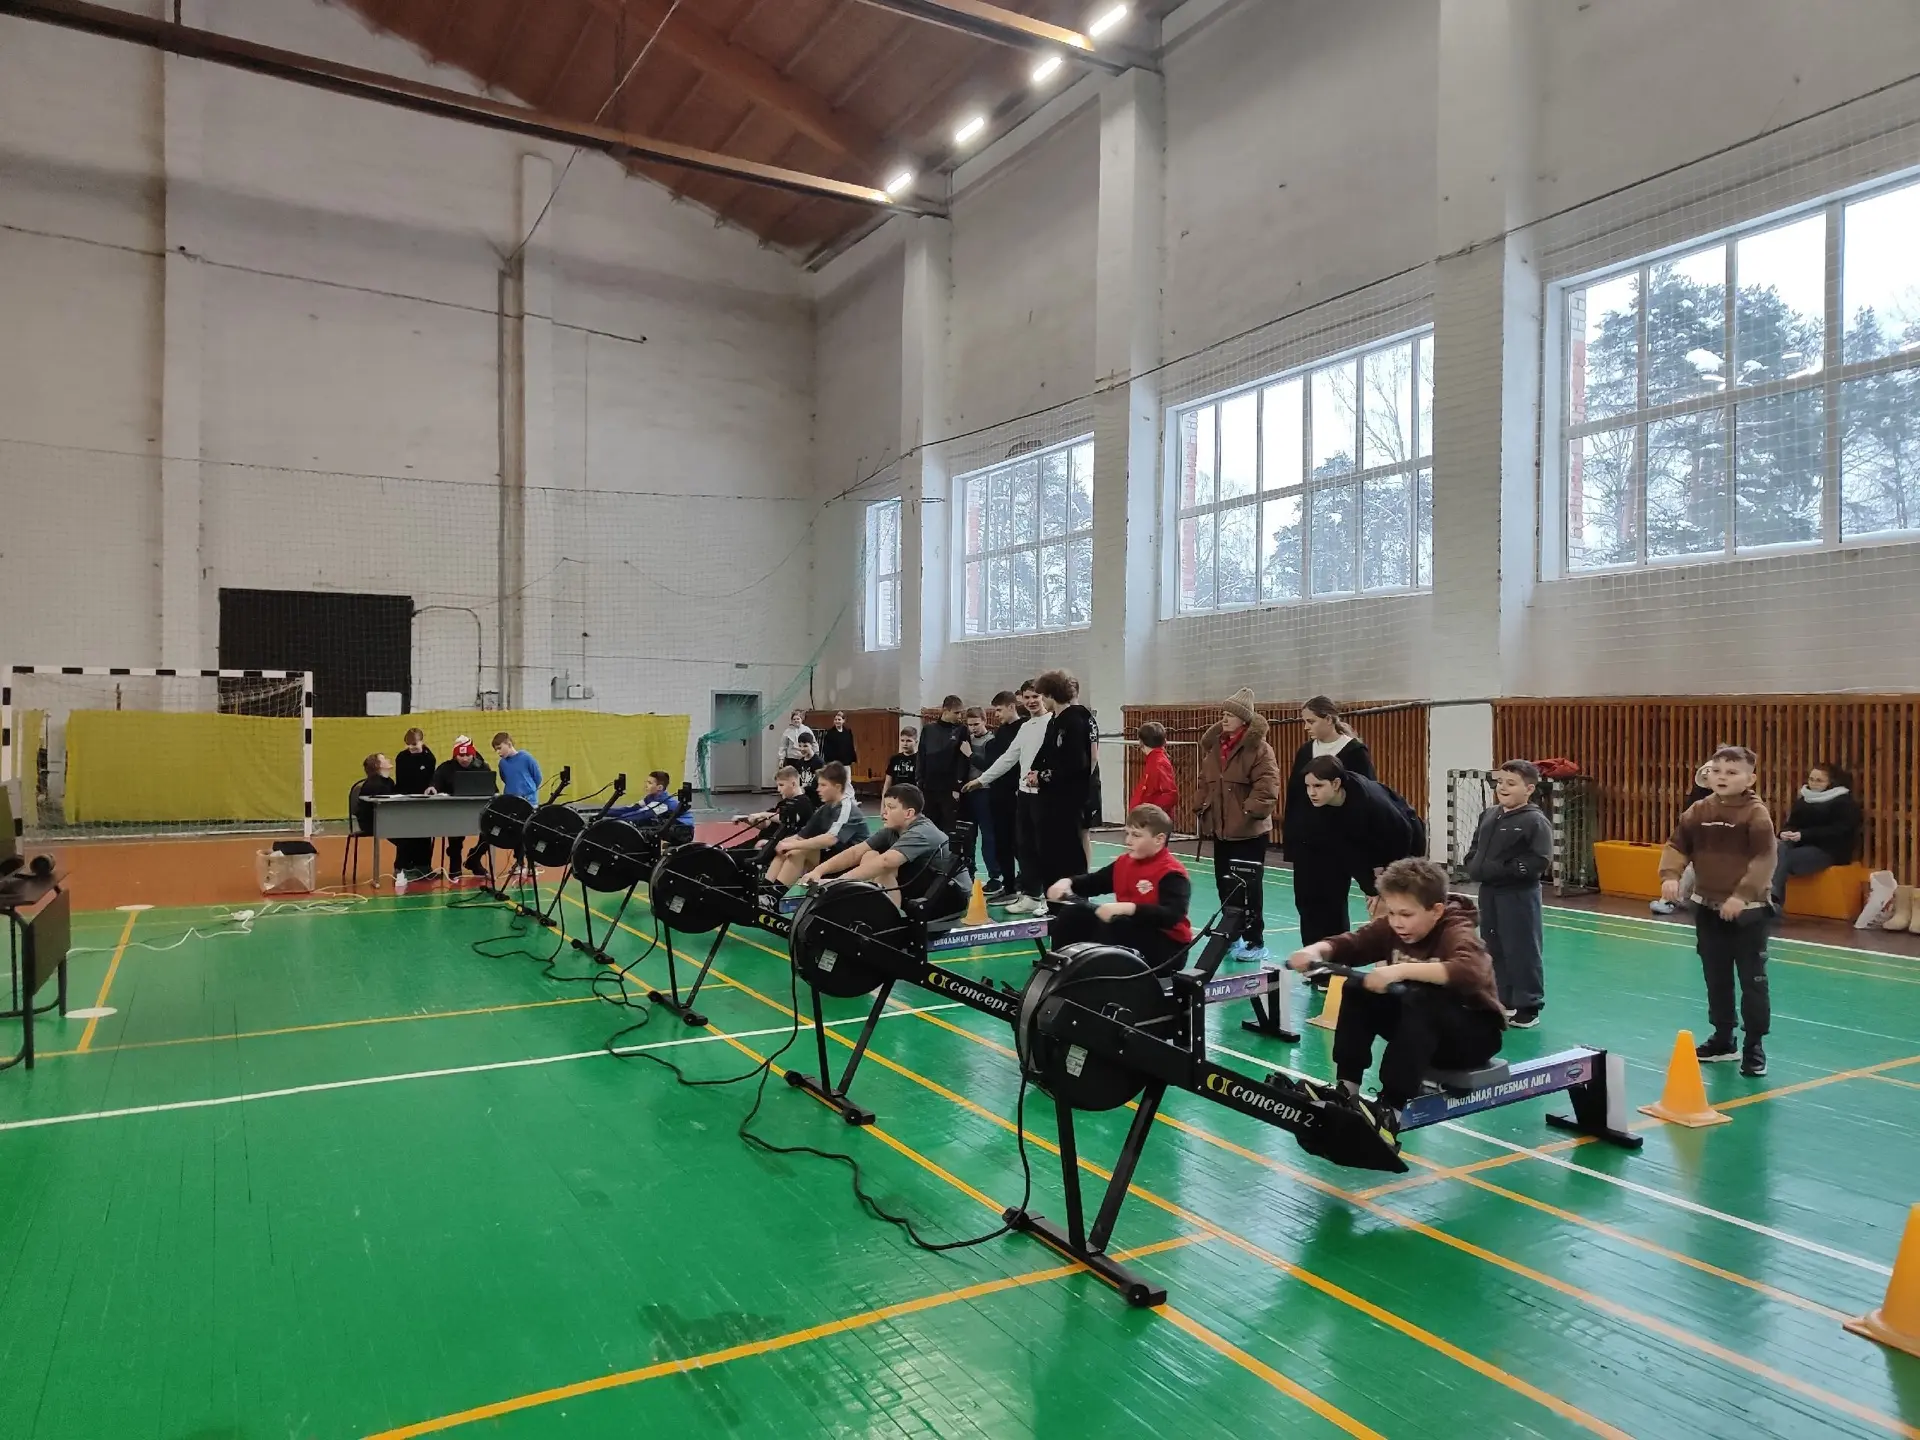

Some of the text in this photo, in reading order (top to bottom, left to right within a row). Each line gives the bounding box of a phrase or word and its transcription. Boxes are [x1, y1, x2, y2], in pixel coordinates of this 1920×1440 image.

[970, 931, 997, 943] ГРЕБНАЯ
[998, 929, 1015, 939] ЛИГА
[949, 981, 1009, 1012] concept
[1212, 984, 1231, 996] ЛИГА
[1494, 1077, 1529, 1097] ГРЕБНАЯ
[1530, 1072, 1551, 1088] ЛИГА
[1231, 1085, 1315, 1128] concept 2
